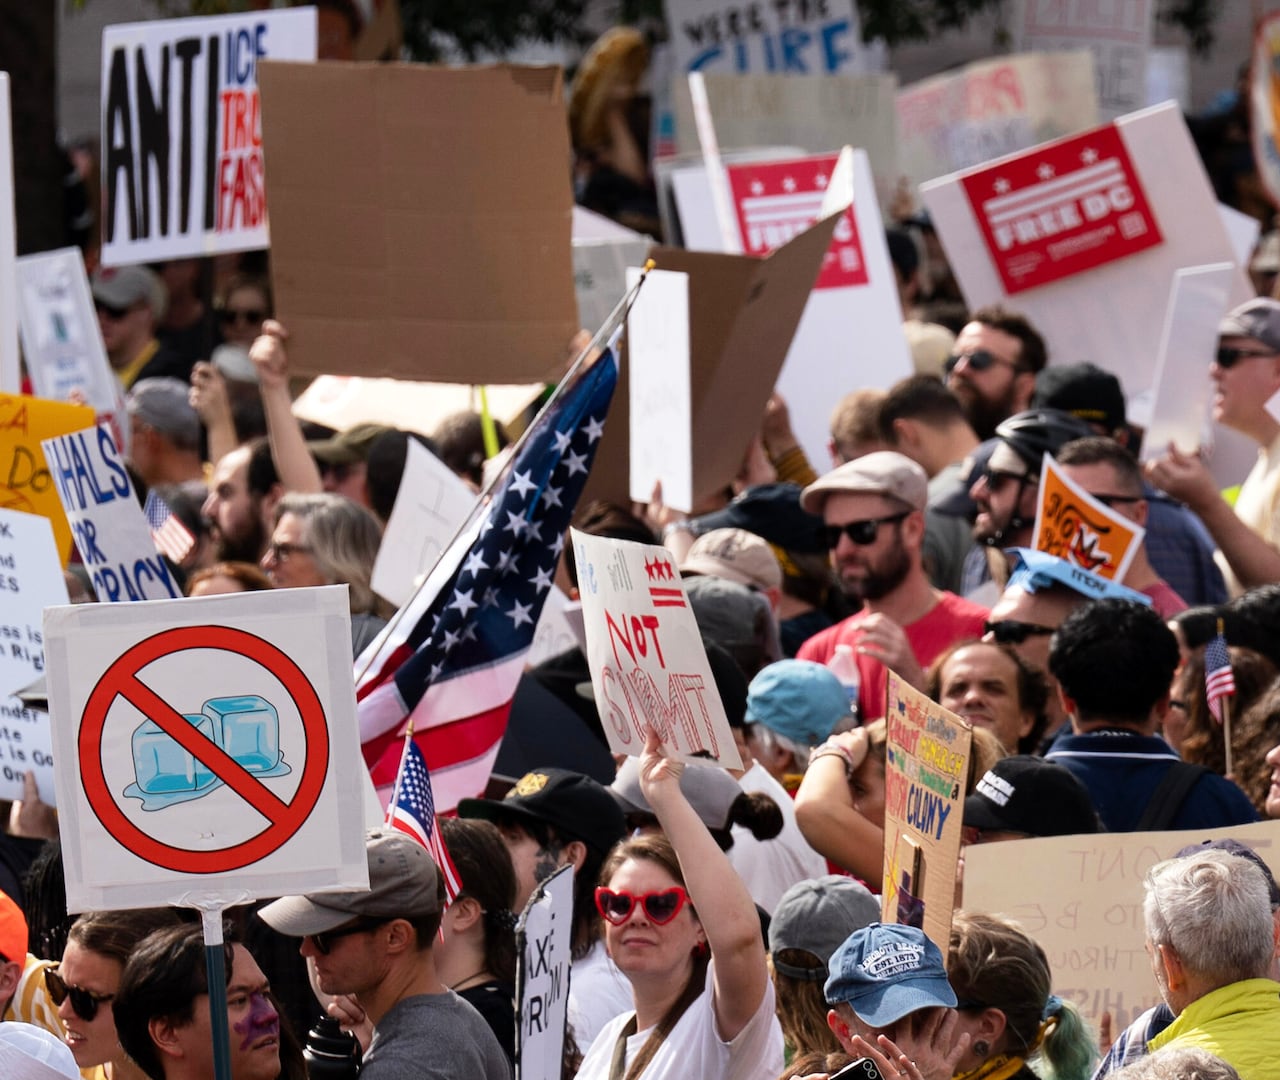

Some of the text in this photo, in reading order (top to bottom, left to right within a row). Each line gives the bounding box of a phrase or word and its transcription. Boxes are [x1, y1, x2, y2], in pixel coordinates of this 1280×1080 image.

[106, 36, 220, 243] ANTI
[993, 203, 1084, 252] FREE
[1082, 183, 1136, 222] DC
[604, 607, 666, 672] NOT
